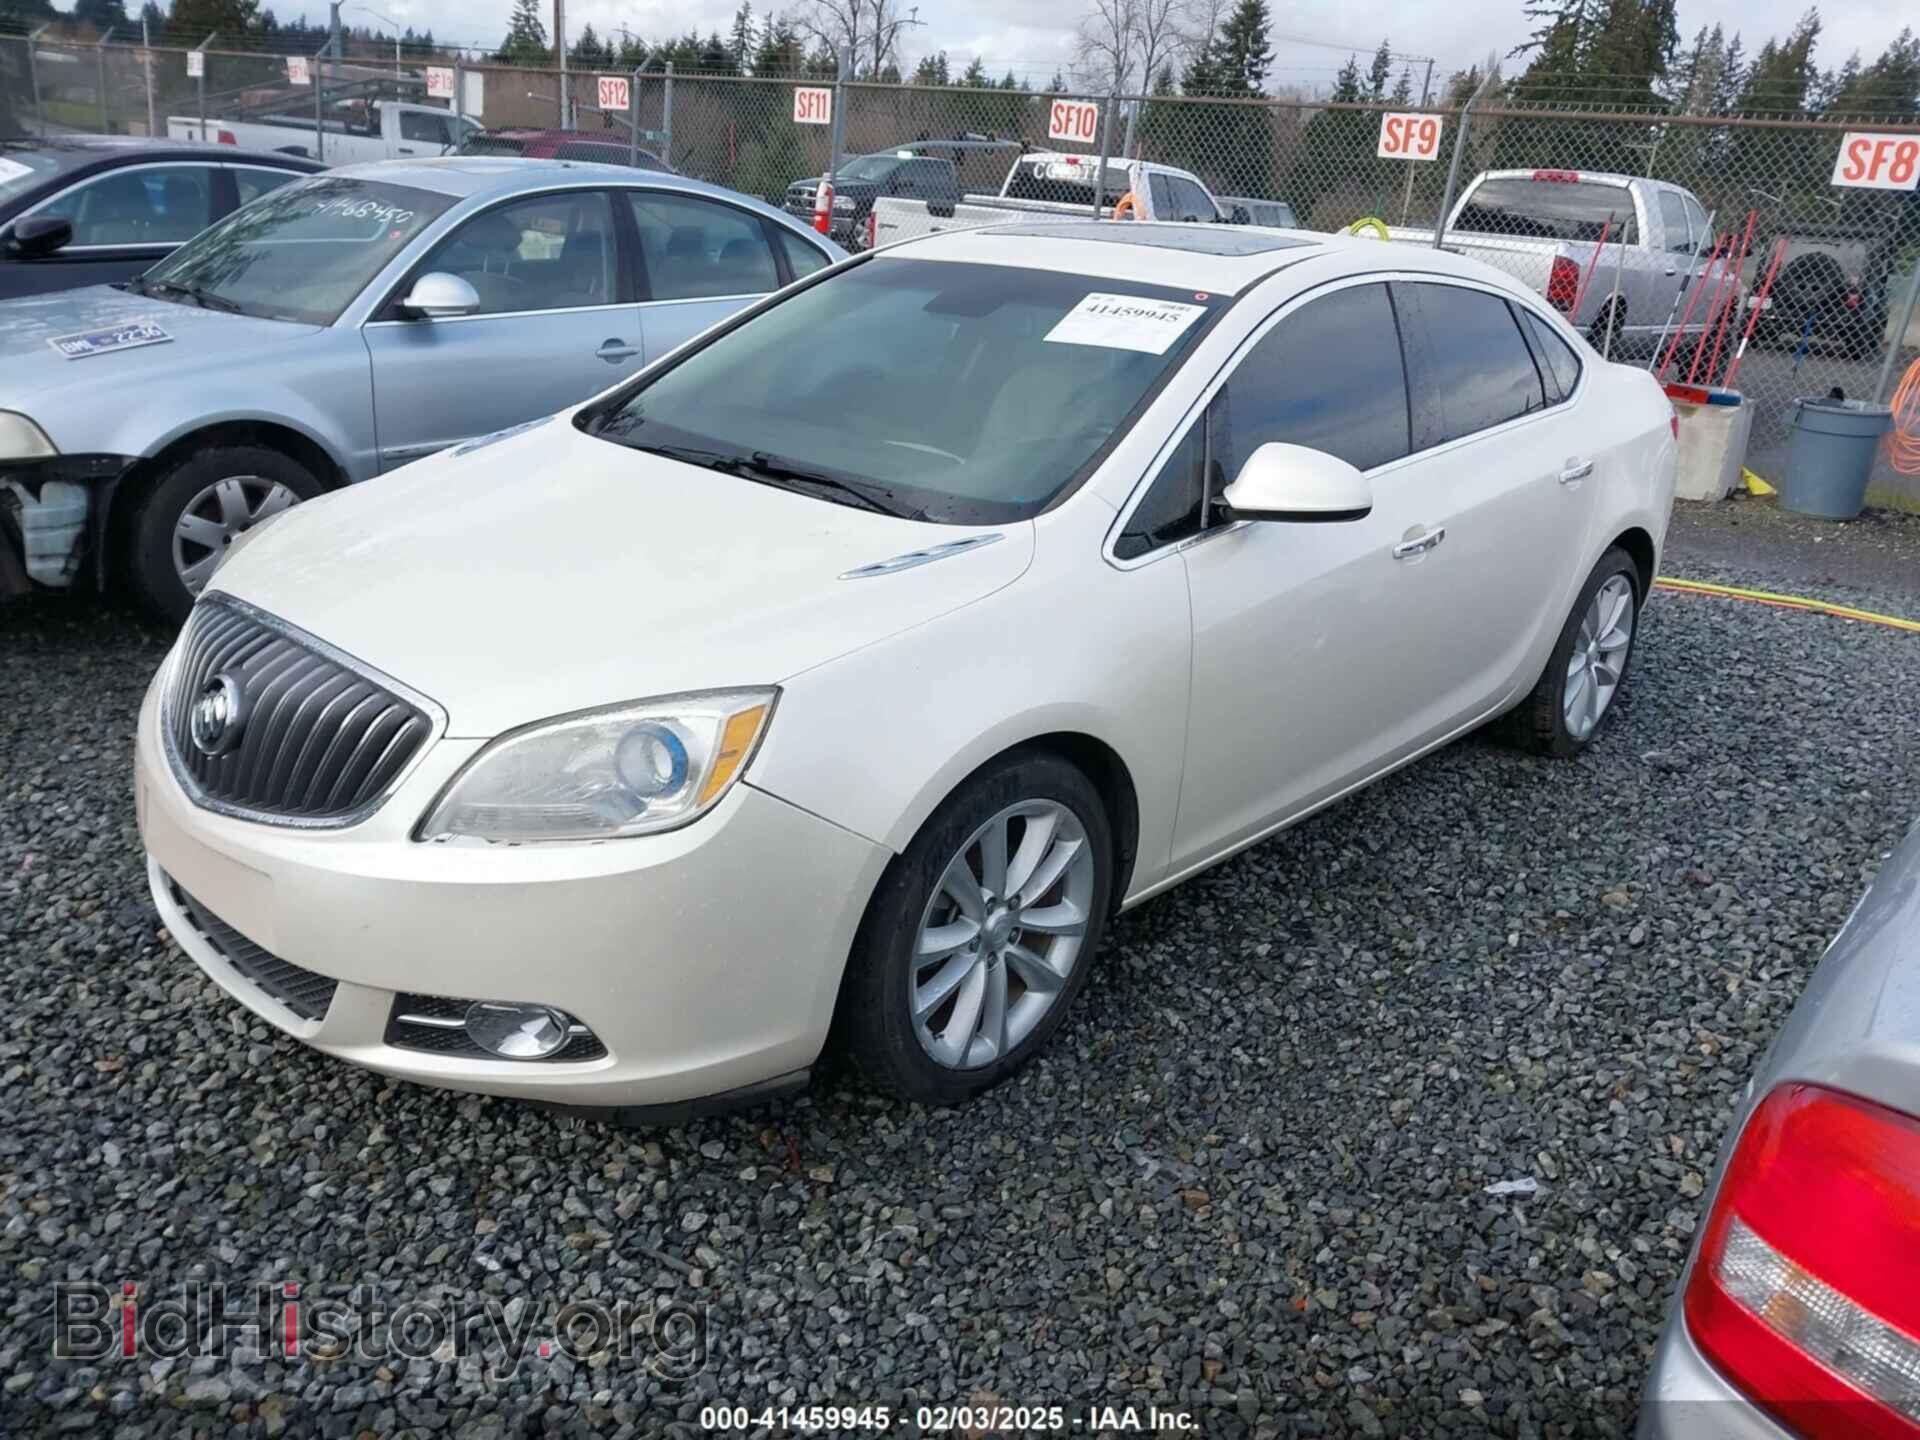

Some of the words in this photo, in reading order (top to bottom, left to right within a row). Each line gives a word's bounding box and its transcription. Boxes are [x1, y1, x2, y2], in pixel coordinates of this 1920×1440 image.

[600, 79, 627, 106] SF12
[798, 91, 826, 120] SF11
[1052, 103, 1095, 138] SF10
[1384, 117, 1437, 155] SF9
[1843, 138, 1919, 183] SF8
[1086, 303, 1182, 323] 41459945
